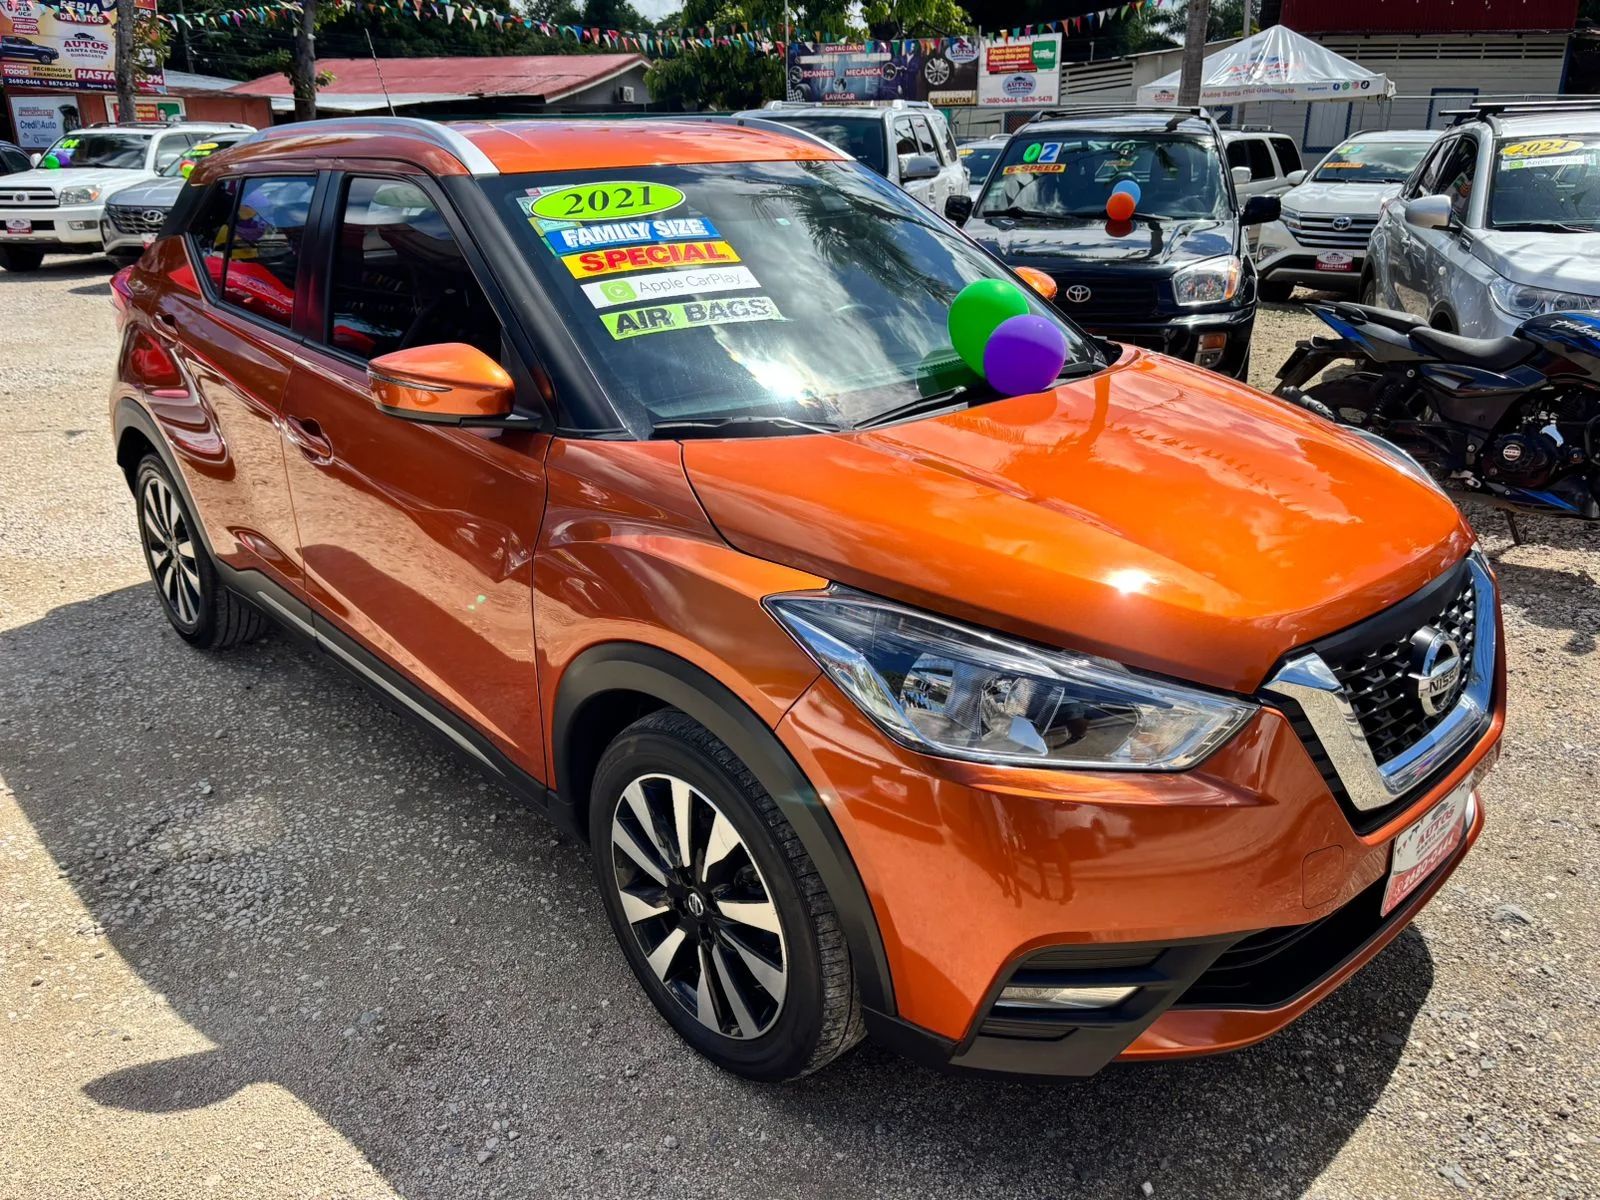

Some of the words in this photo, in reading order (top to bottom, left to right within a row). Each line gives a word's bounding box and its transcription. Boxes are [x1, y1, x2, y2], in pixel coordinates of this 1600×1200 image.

[64, 40, 109, 50] AUTOS
[4, 68, 30, 76] TODOS
[77, 69, 116, 81] HASTA
[803, 70, 835, 78] SCANNER
[8, 78, 41, 86] 2680-0444
[1022, 143, 1060, 162] 02
[1526, 159, 1550, 167] Apple
[562, 185, 656, 216] 2021
[561, 221, 651, 248] FAMILY
[652, 217, 710, 238] SIZE
[579, 242, 727, 273] SPECIAL
[638, 278, 685, 294] Apple
[685, 271, 742, 287] CarPlay
[616, 306, 676, 336] AIR
[682, 298, 772, 323] BAGS
[1418, 805, 1456, 844] AUTOS
